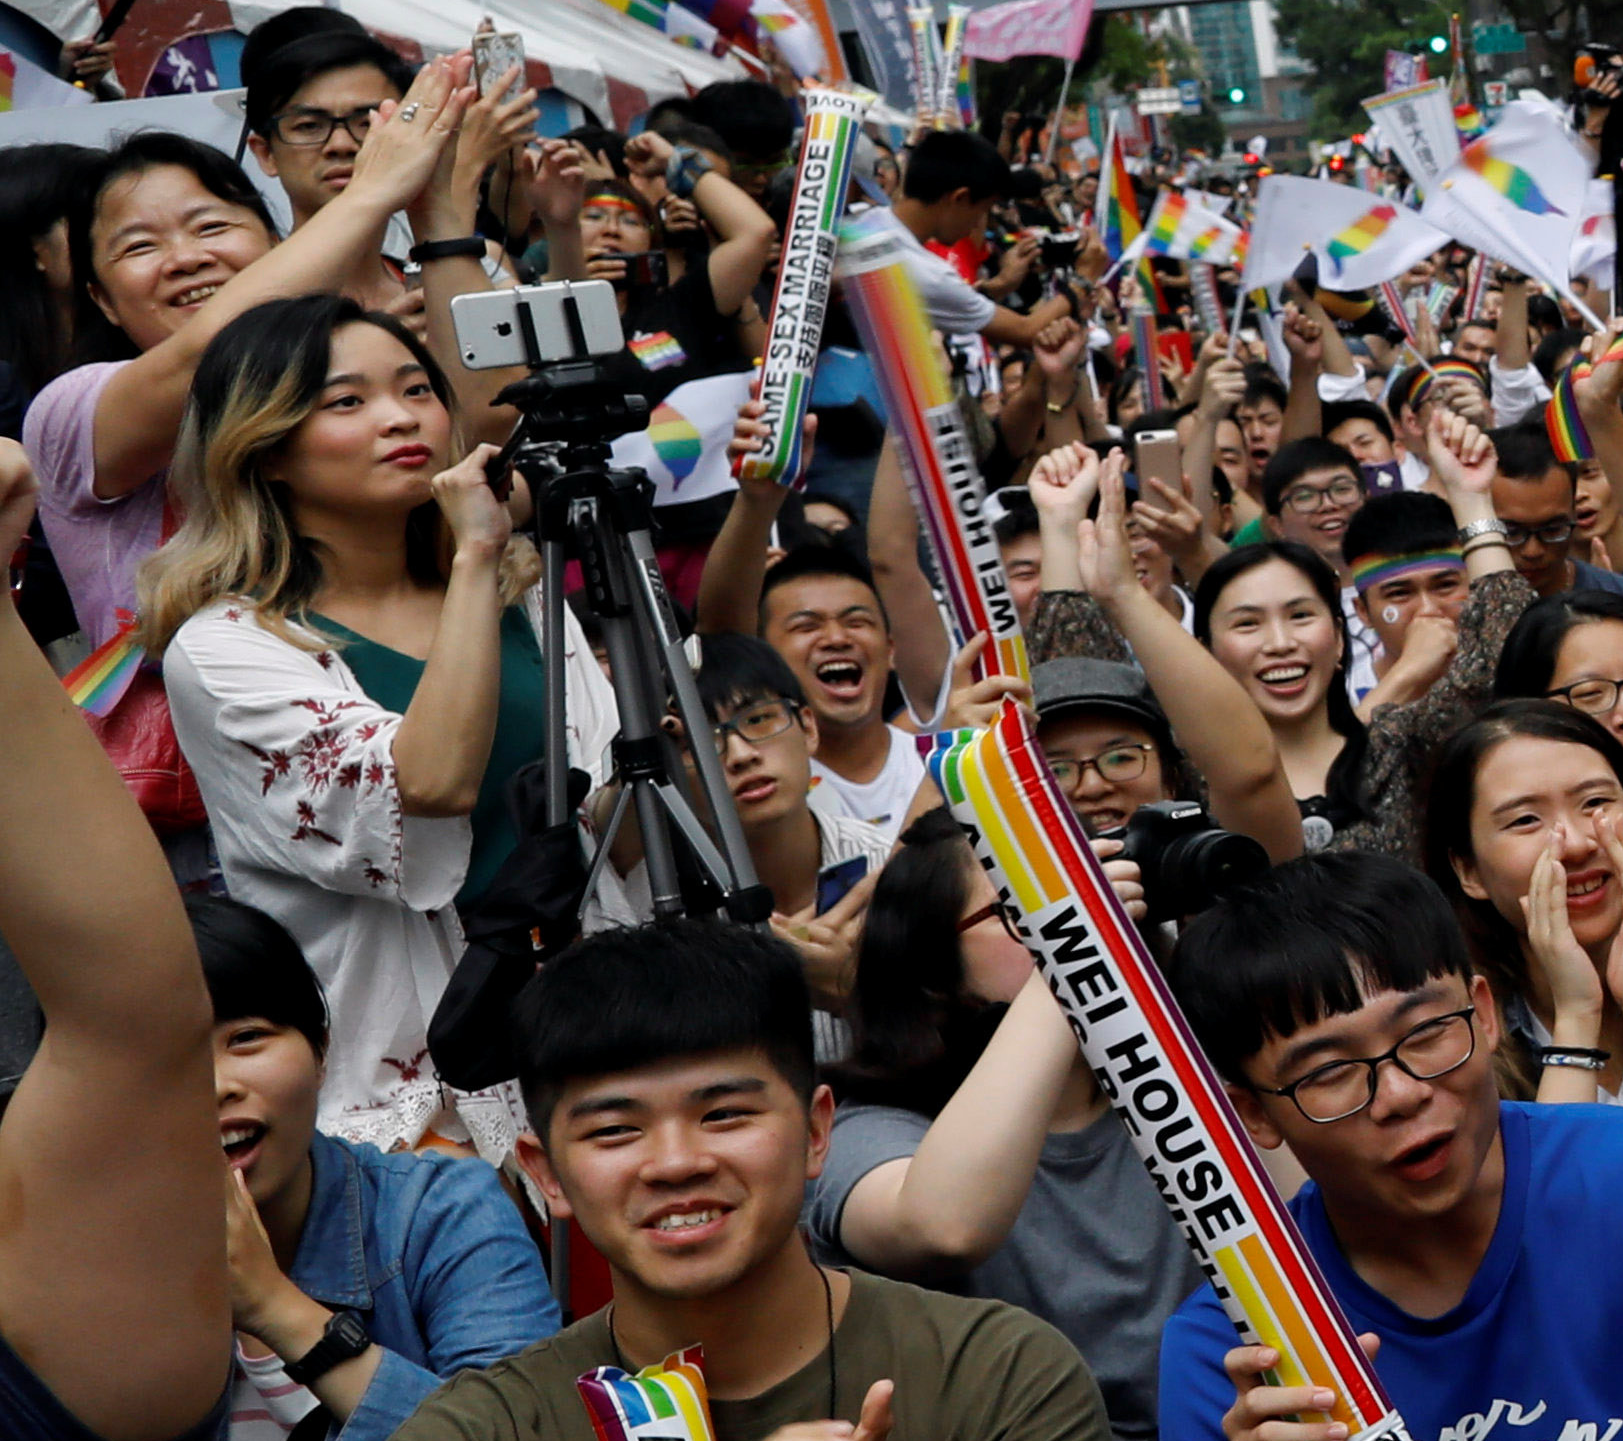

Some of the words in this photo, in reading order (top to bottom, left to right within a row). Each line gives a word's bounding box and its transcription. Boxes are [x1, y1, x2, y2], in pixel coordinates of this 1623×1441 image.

[783, 142, 831, 298] MARRIAGE
[1039, 903, 1129, 1026] WEI
[1104, 1031, 1248, 1243] HOUSE
